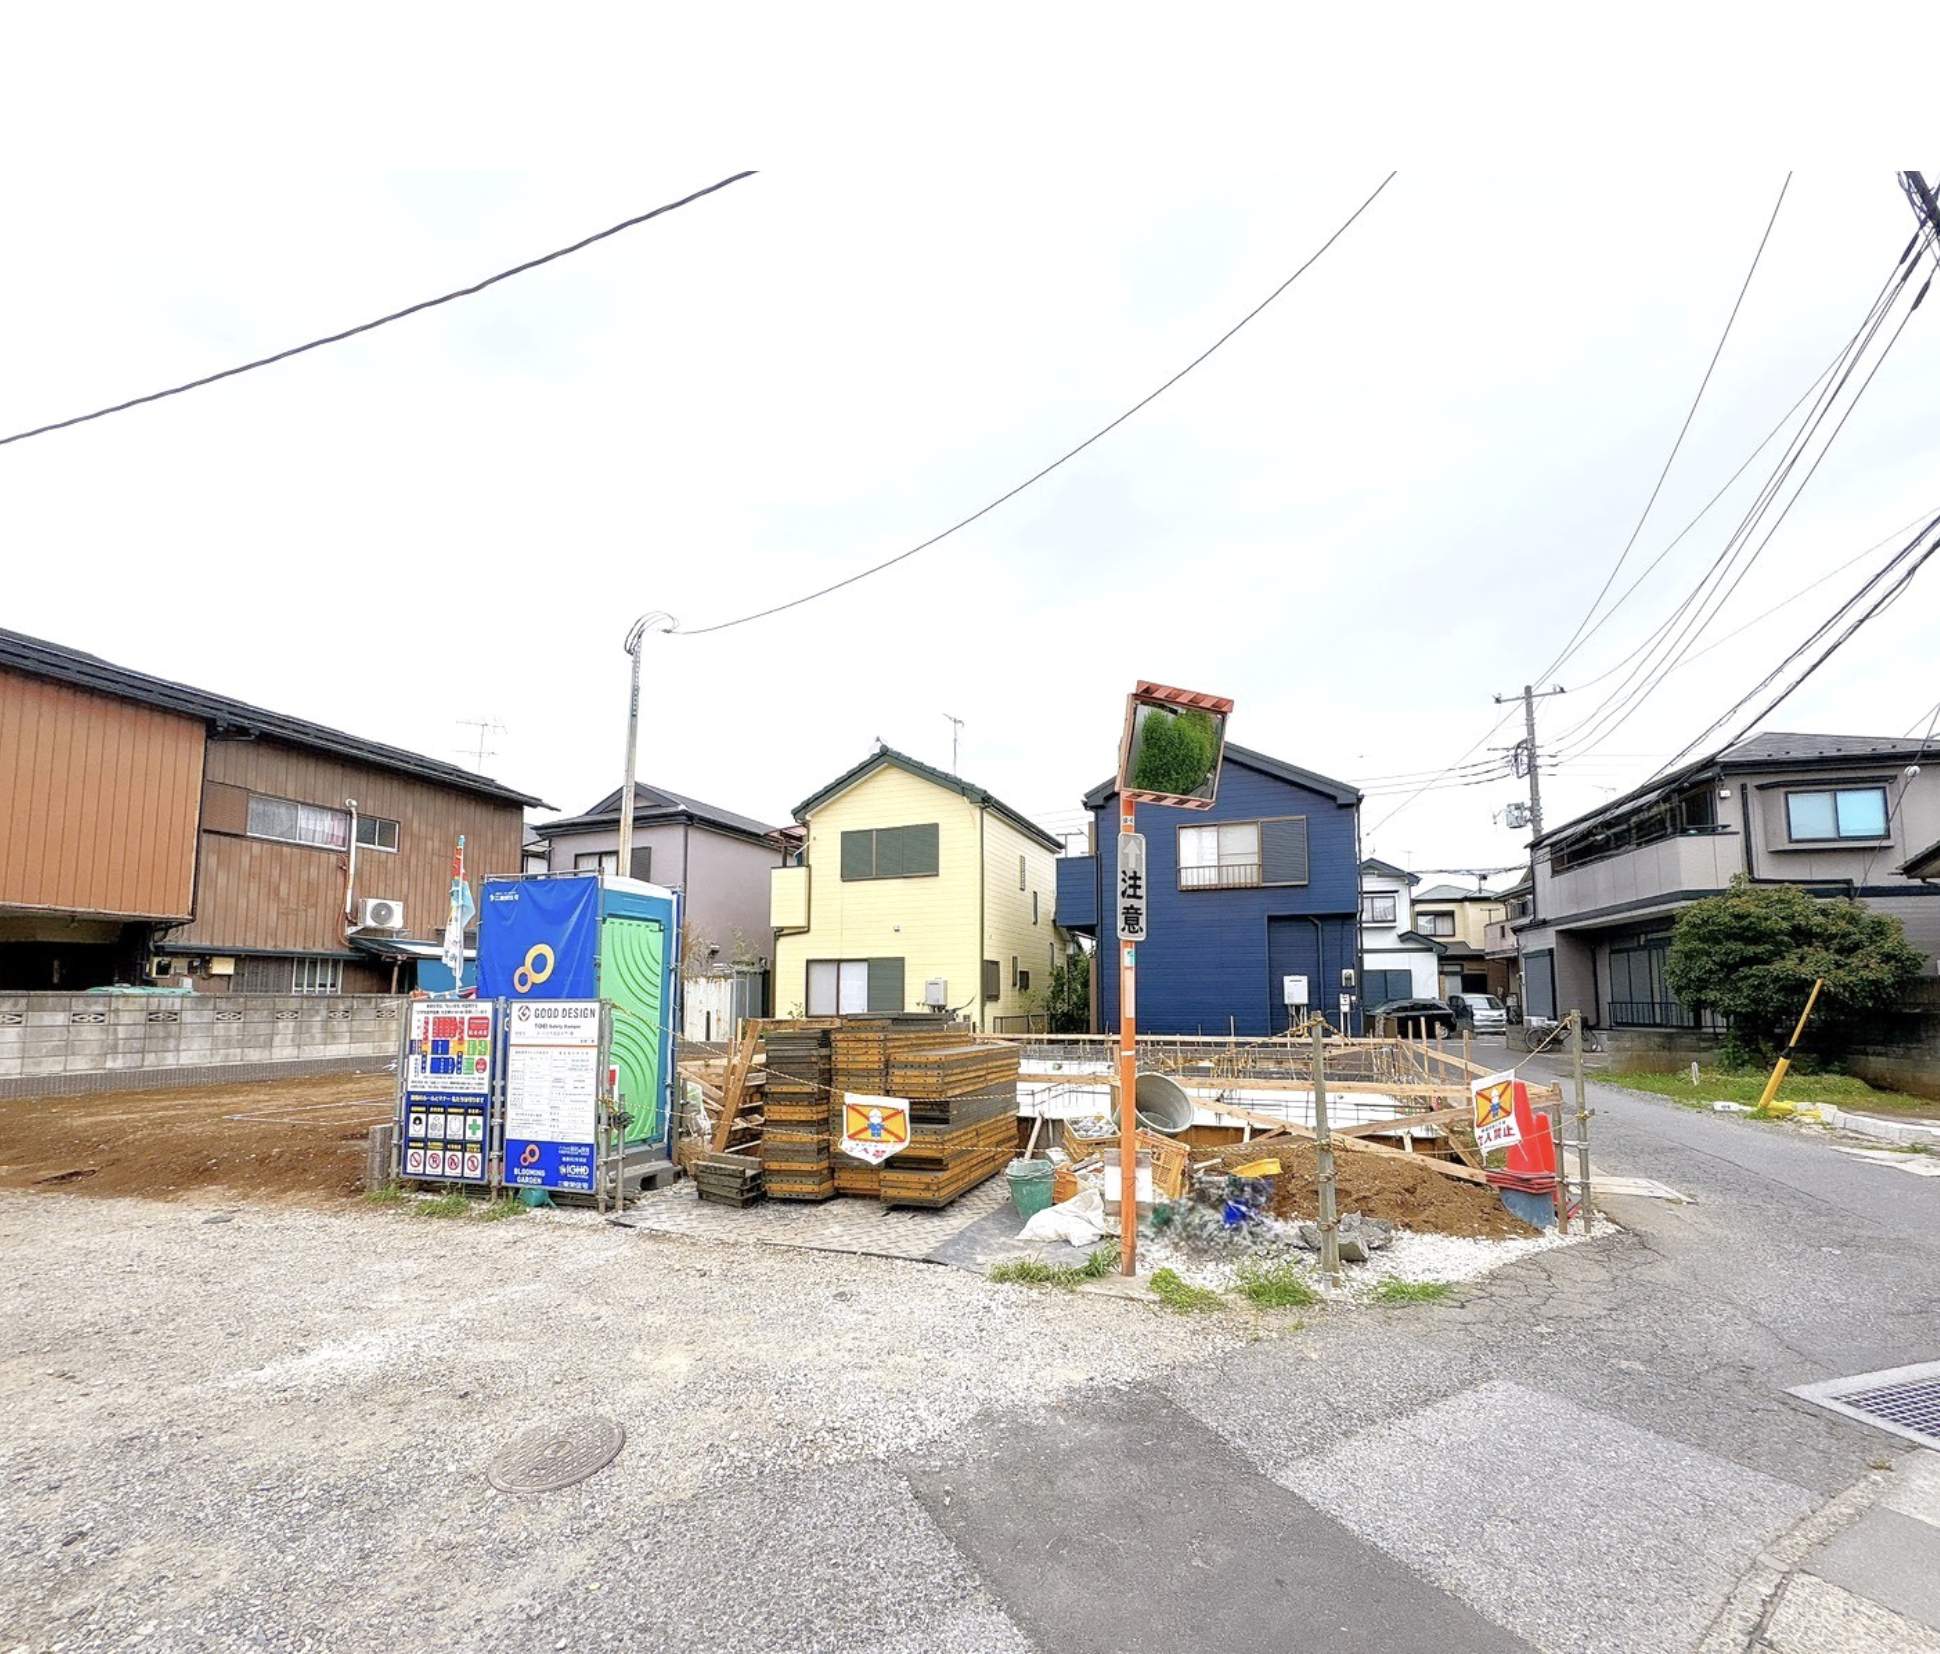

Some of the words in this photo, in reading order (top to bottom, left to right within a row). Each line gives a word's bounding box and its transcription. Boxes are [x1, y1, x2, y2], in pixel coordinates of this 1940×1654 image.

[1121, 870, 1143, 934] 注意
[534, 1007, 559, 1019] GOOD
[561, 1007, 595, 1019] DESIGN
[513, 1167, 545, 1177] BLOOMING
[516, 1176, 542, 1184] GARDEN
